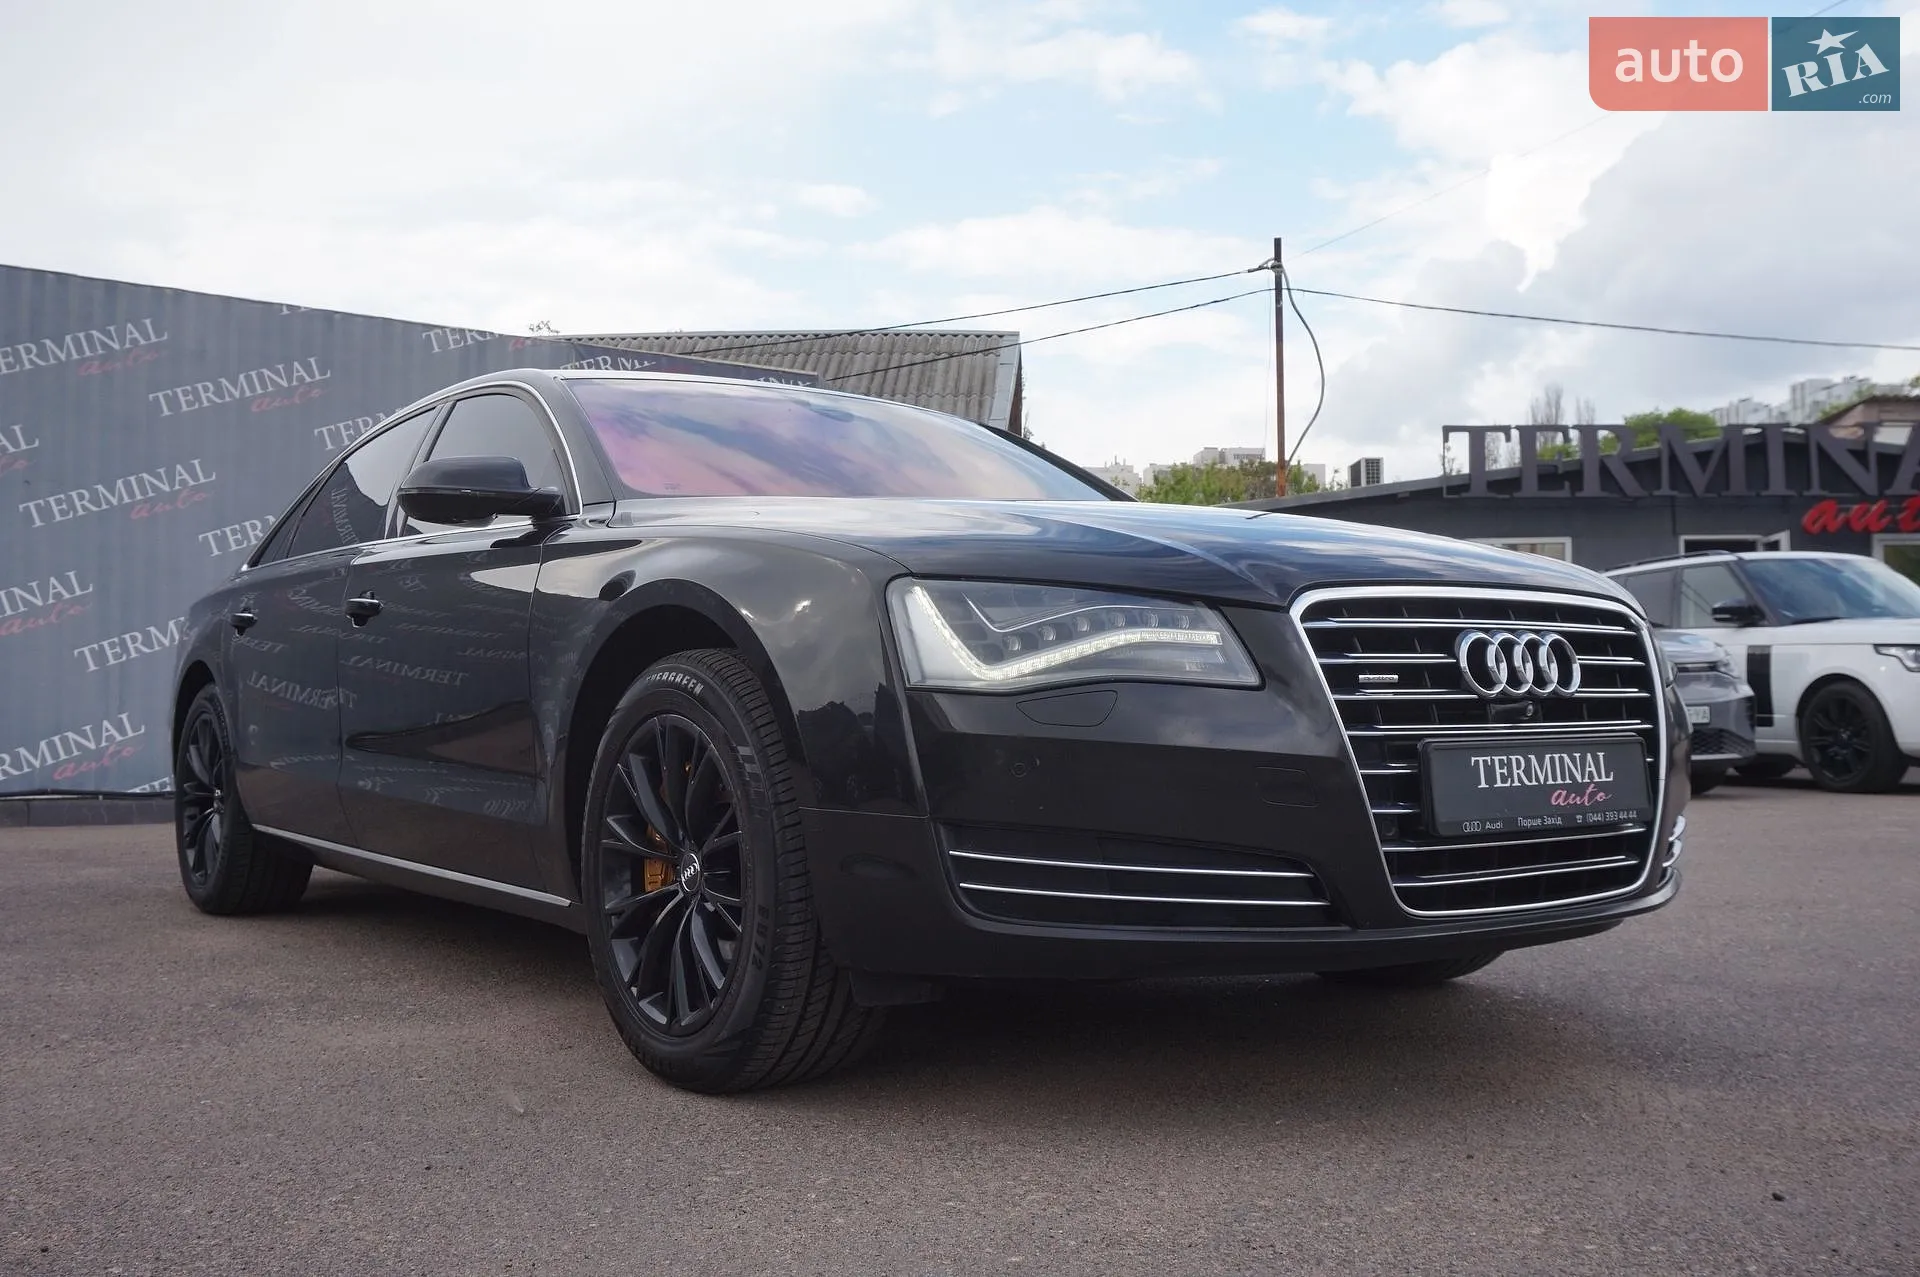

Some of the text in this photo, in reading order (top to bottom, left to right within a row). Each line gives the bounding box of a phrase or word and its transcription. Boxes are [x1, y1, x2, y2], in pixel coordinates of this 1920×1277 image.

[422, 328, 499, 354] TER
[149, 356, 331, 417] TERMINAL
[250, 383, 330, 413] auto
[314, 407, 402, 450] TER
[19, 457, 217, 528] TERMINAL
[129, 487, 214, 521] auto
[198, 514, 277, 557] TER
[52, 744, 145, 781] auto
[1471, 752, 1614, 788] TERMINAL
[1550, 783, 1613, 806] auto
[1485, 821, 1504, 830] Audi
